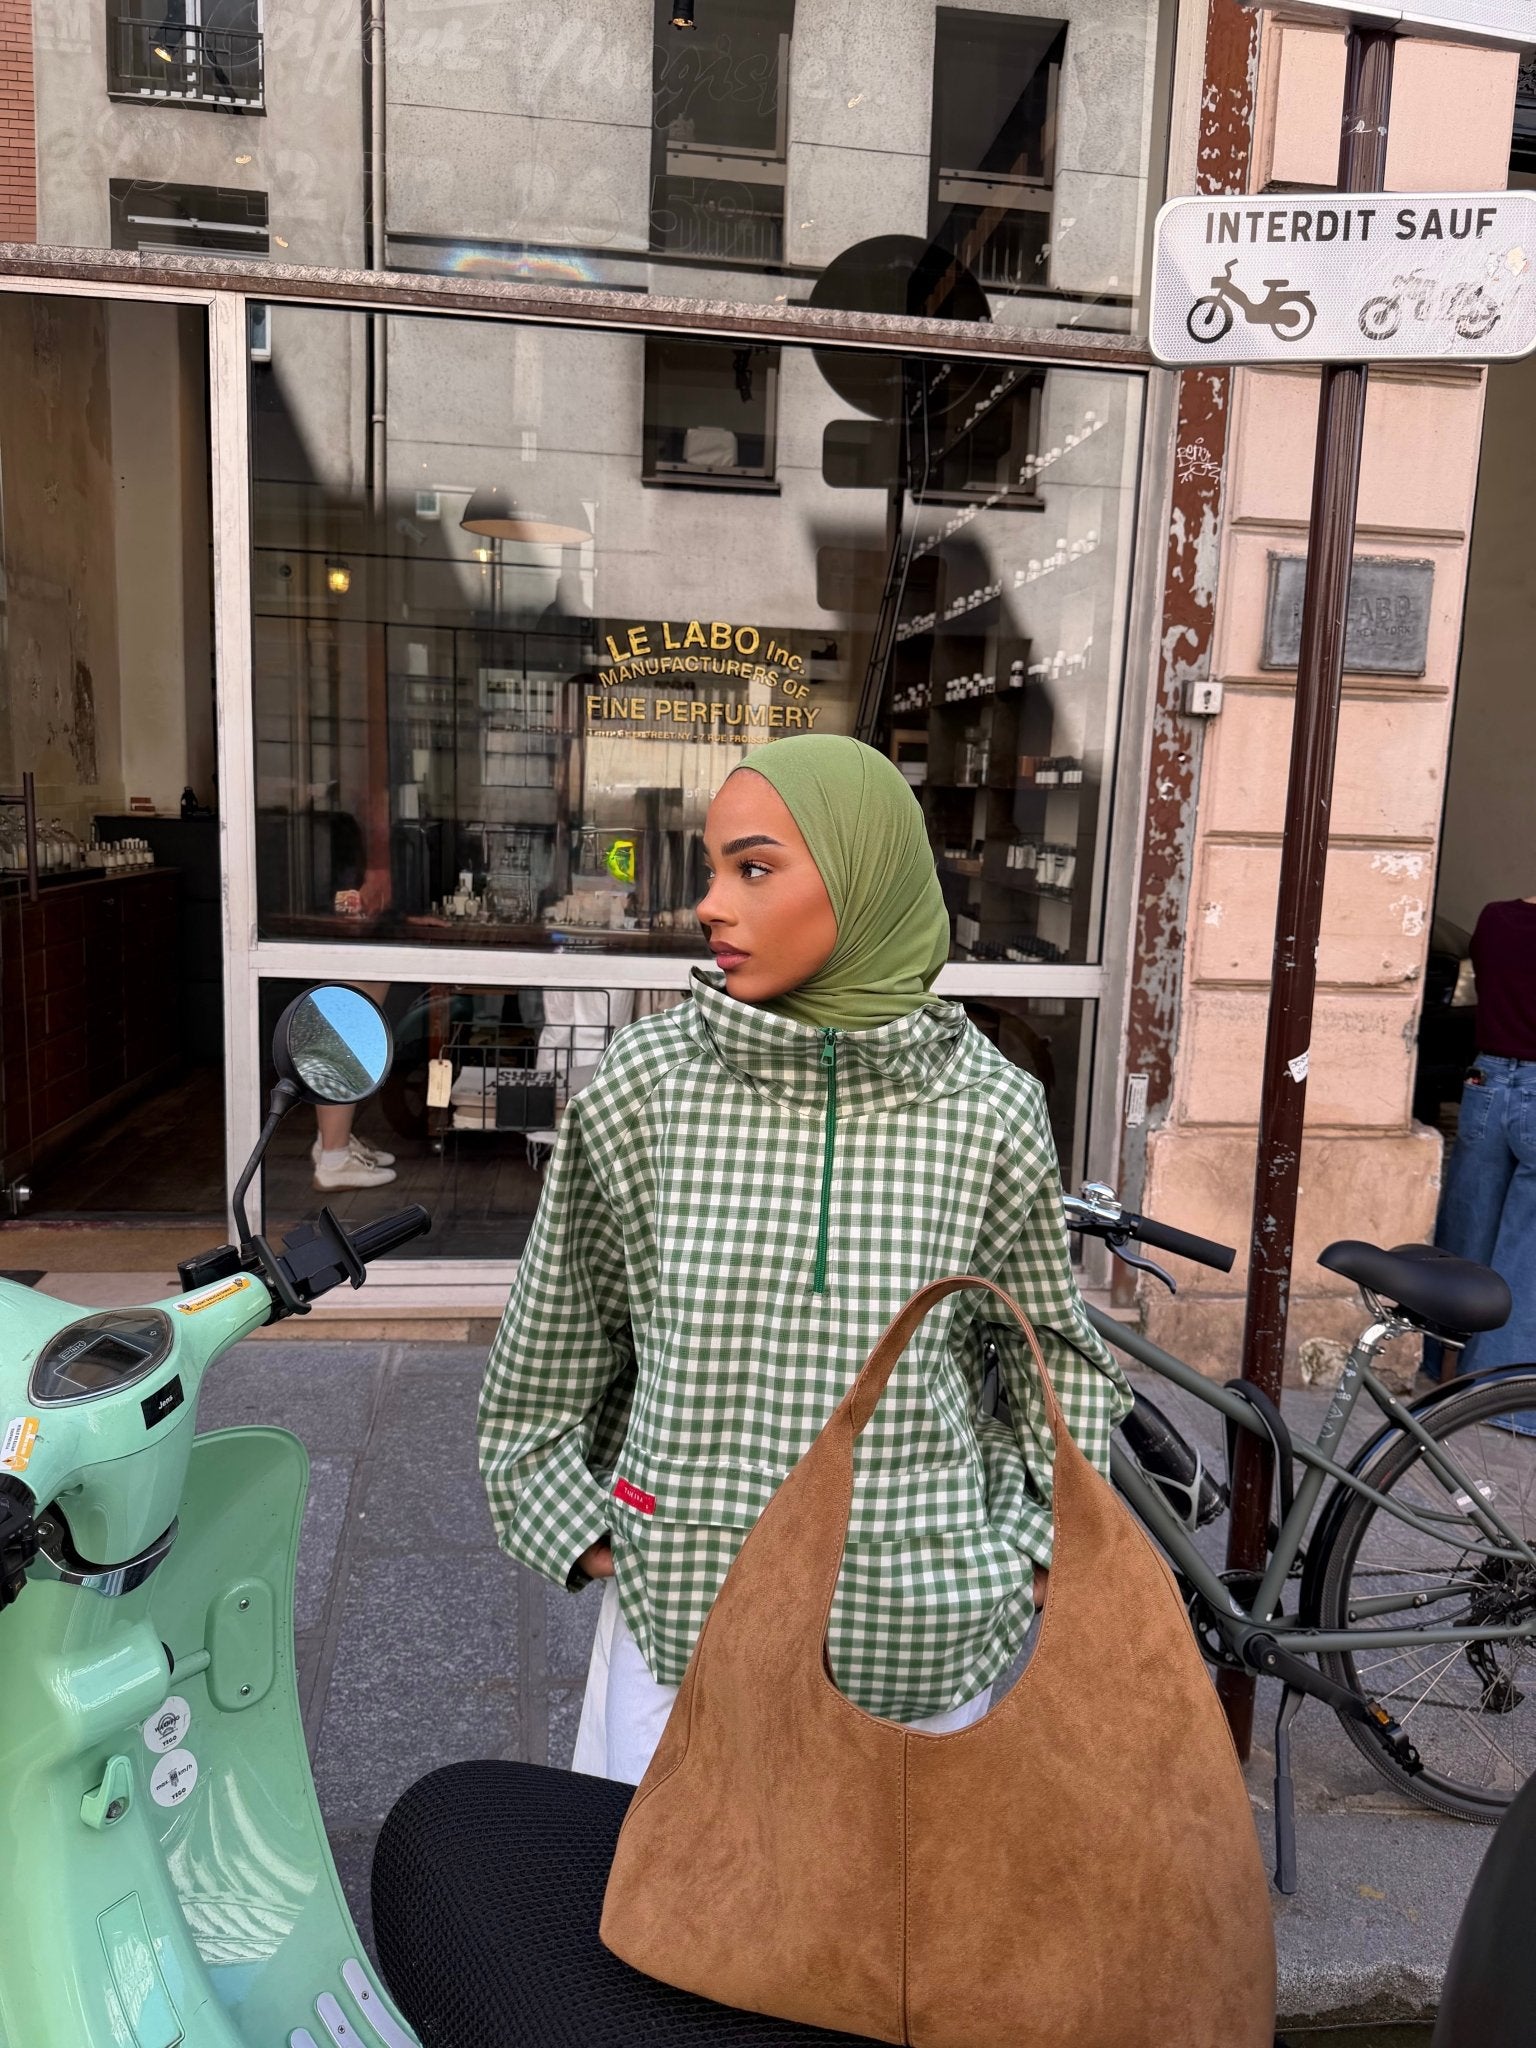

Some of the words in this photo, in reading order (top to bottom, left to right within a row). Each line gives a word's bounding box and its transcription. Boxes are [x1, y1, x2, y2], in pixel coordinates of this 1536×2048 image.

[1206, 209, 1376, 244] INTERDIT
[1396, 207, 1498, 240] SAUF
[605, 626, 651, 664] LE
[662, 620, 760, 655] LABO
[766, 640, 807, 675] Inc.
[598, 656, 779, 689] MANUFACTURERS
[782, 679, 810, 700] OF
[586, 695, 646, 720] FINE
[655, 699, 821, 729] PERFUMERY
[707, 734, 727, 742] RUE
[158, 1394, 174, 1410] Jens
